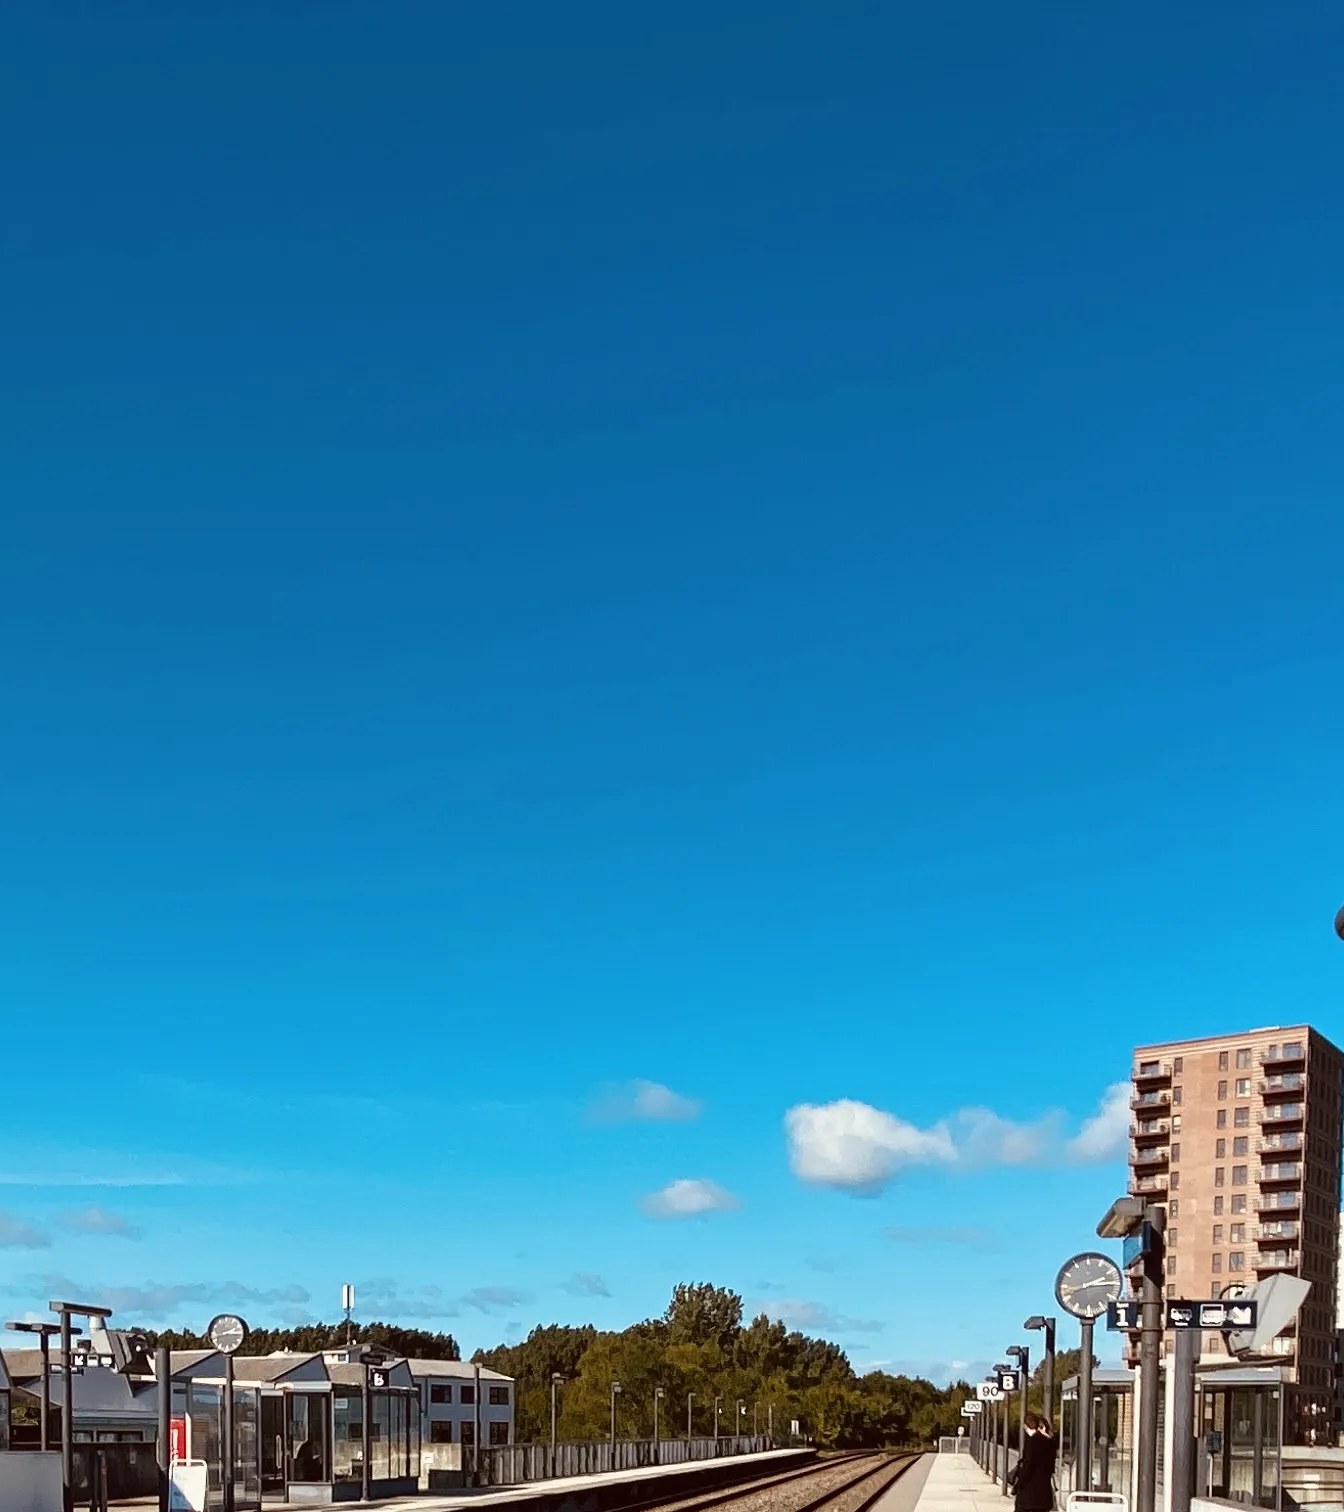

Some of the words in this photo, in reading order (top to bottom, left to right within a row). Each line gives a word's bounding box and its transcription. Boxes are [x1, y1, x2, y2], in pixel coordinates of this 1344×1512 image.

[1116, 1308, 1129, 1327] 1
[1002, 1375, 1015, 1390] B
[982, 1386, 999, 1397] 90
